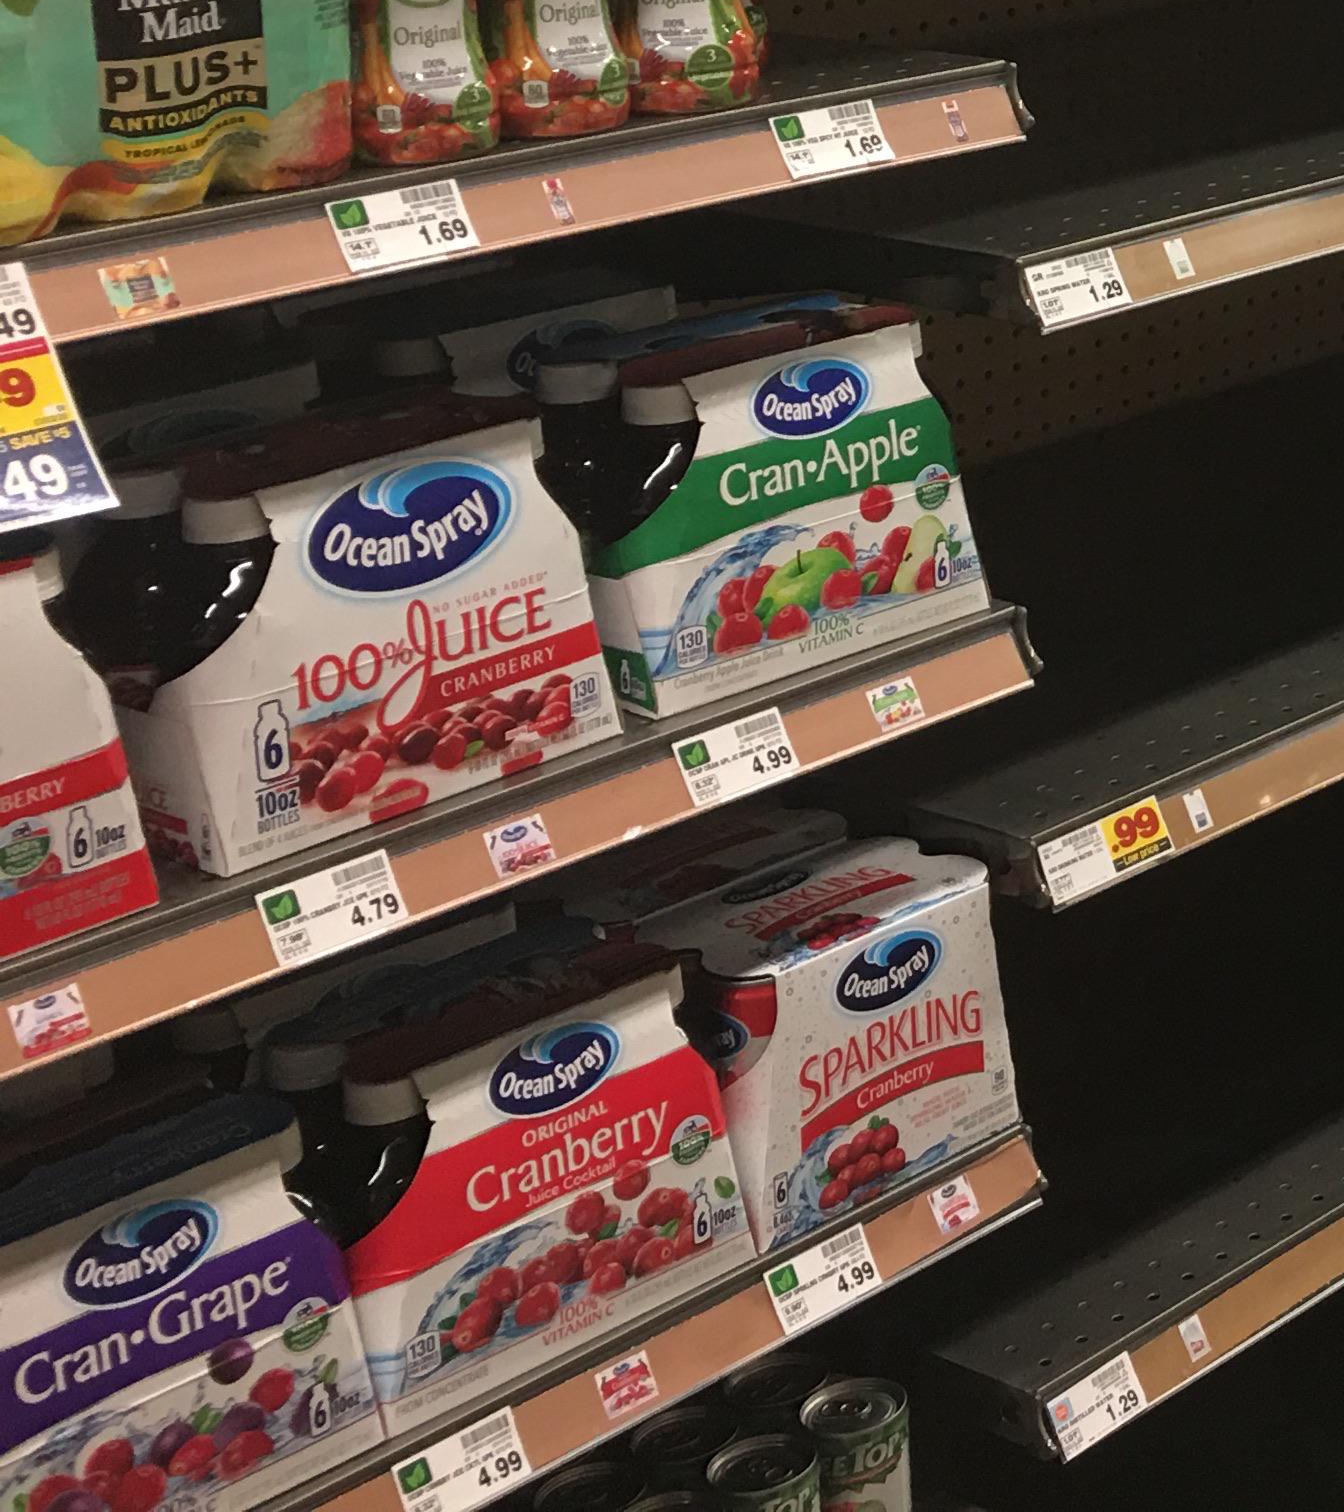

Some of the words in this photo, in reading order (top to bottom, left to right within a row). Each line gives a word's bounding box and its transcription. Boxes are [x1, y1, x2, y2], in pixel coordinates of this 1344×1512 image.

[138, 8, 223, 44] Maid
[539, 1, 600, 26] Original
[393, 19, 462, 48] Original
[104, 49, 259, 105] PLUS+
[108, 88, 259, 133] ANTIOXIDANTS
[124, 142, 190, 160] TROPICAL
[844, 133, 884, 159] 1.69
[418, 218, 468, 246] 1.69
[1089, 279, 1124, 303] 1.29
[761, 392, 812, 423] Ocean
[813, 376, 857, 420] Spray
[323, 520, 411, 569] Ocean
[414, 488, 491, 559] Spray
[431, 600, 452, 616] NO
[454, 587, 498, 610] SUGAR
[679, 629, 705, 649] 130
[798, 625, 854, 656] VITAMIN
[854, 621, 865, 637] C
[811, 611, 851, 637] 100%
[291, 640, 416, 713] 100%
[376, 586, 553, 734] JUICE
[439, 644, 559, 699] CRANBERRY
[573, 676, 597, 698] 130
[263, 737, 284, 769] 6
[752, 745, 793, 775] 4.99
[255, 787, 300, 816] 10oz
[257, 809, 301, 835] BOTTLES
[1111, 805, 1161, 854] .99
[351, 892, 400, 928] 4.79
[724, 864, 894, 934] SPARKLING
[843, 972, 889, 1000] Ocean
[889, 945, 930, 990] Spray
[498, 1070, 551, 1102] Ocean
[552, 1038, 605, 1093] Spray
[800, 989, 983, 1118] SPARKLING
[855, 1058, 936, 1111] Cranberry
[521, 1100, 609, 1149] ORIGINAL
[465, 1101, 671, 1214] Cranberry
[524, 1183, 559, 1210] Juice
[561, 1156, 617, 1193] Cocktail
[75, 1248, 143, 1290] Ocean
[145, 1216, 204, 1274] Spray
[837, 1260, 876, 1294] 4.99
[557, 1293, 600, 1326] 100%
[407, 1334, 437, 1361] 130
[541, 1310, 602, 1349] VITAMIN
[1105, 1388, 1140, 1422] 1.29
[477, 1450, 524, 1488] 4.99
